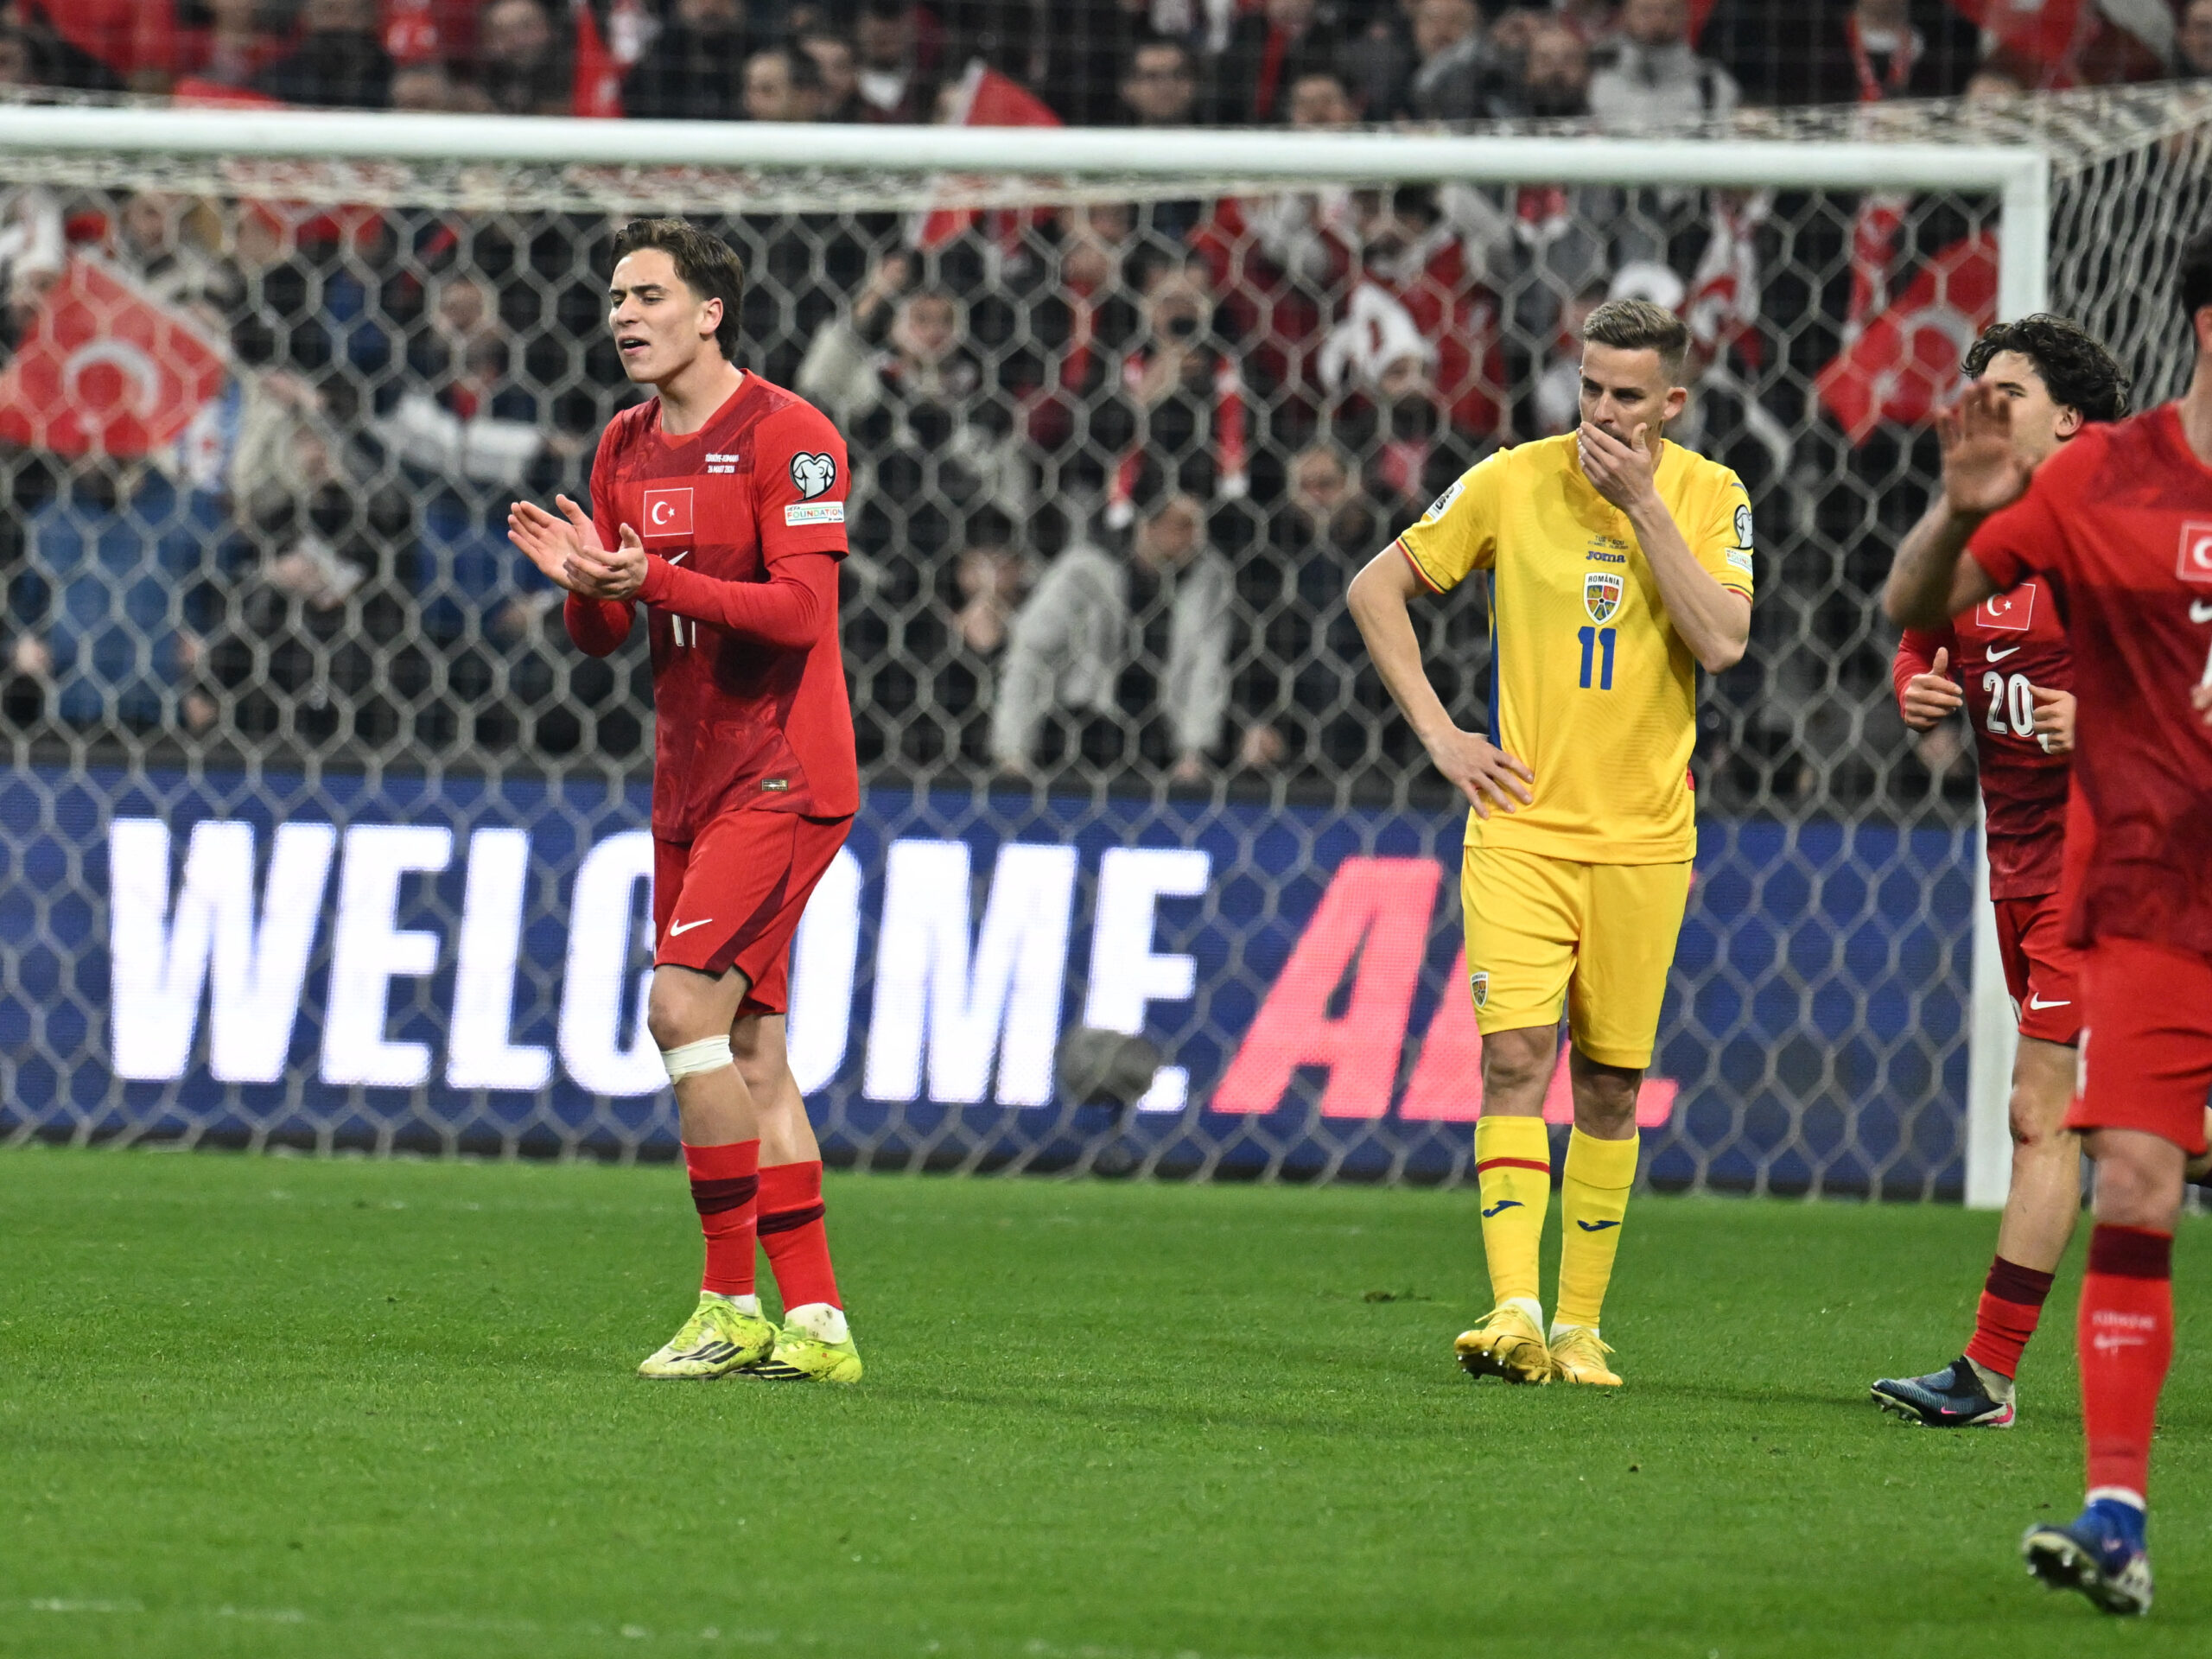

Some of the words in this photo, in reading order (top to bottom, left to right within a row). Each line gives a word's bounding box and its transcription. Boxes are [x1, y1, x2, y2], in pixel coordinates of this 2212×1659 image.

[787, 508, 843, 519] FOUNDATION
[1578, 626, 1617, 690] 11
[1983, 671, 2035, 737] 20
